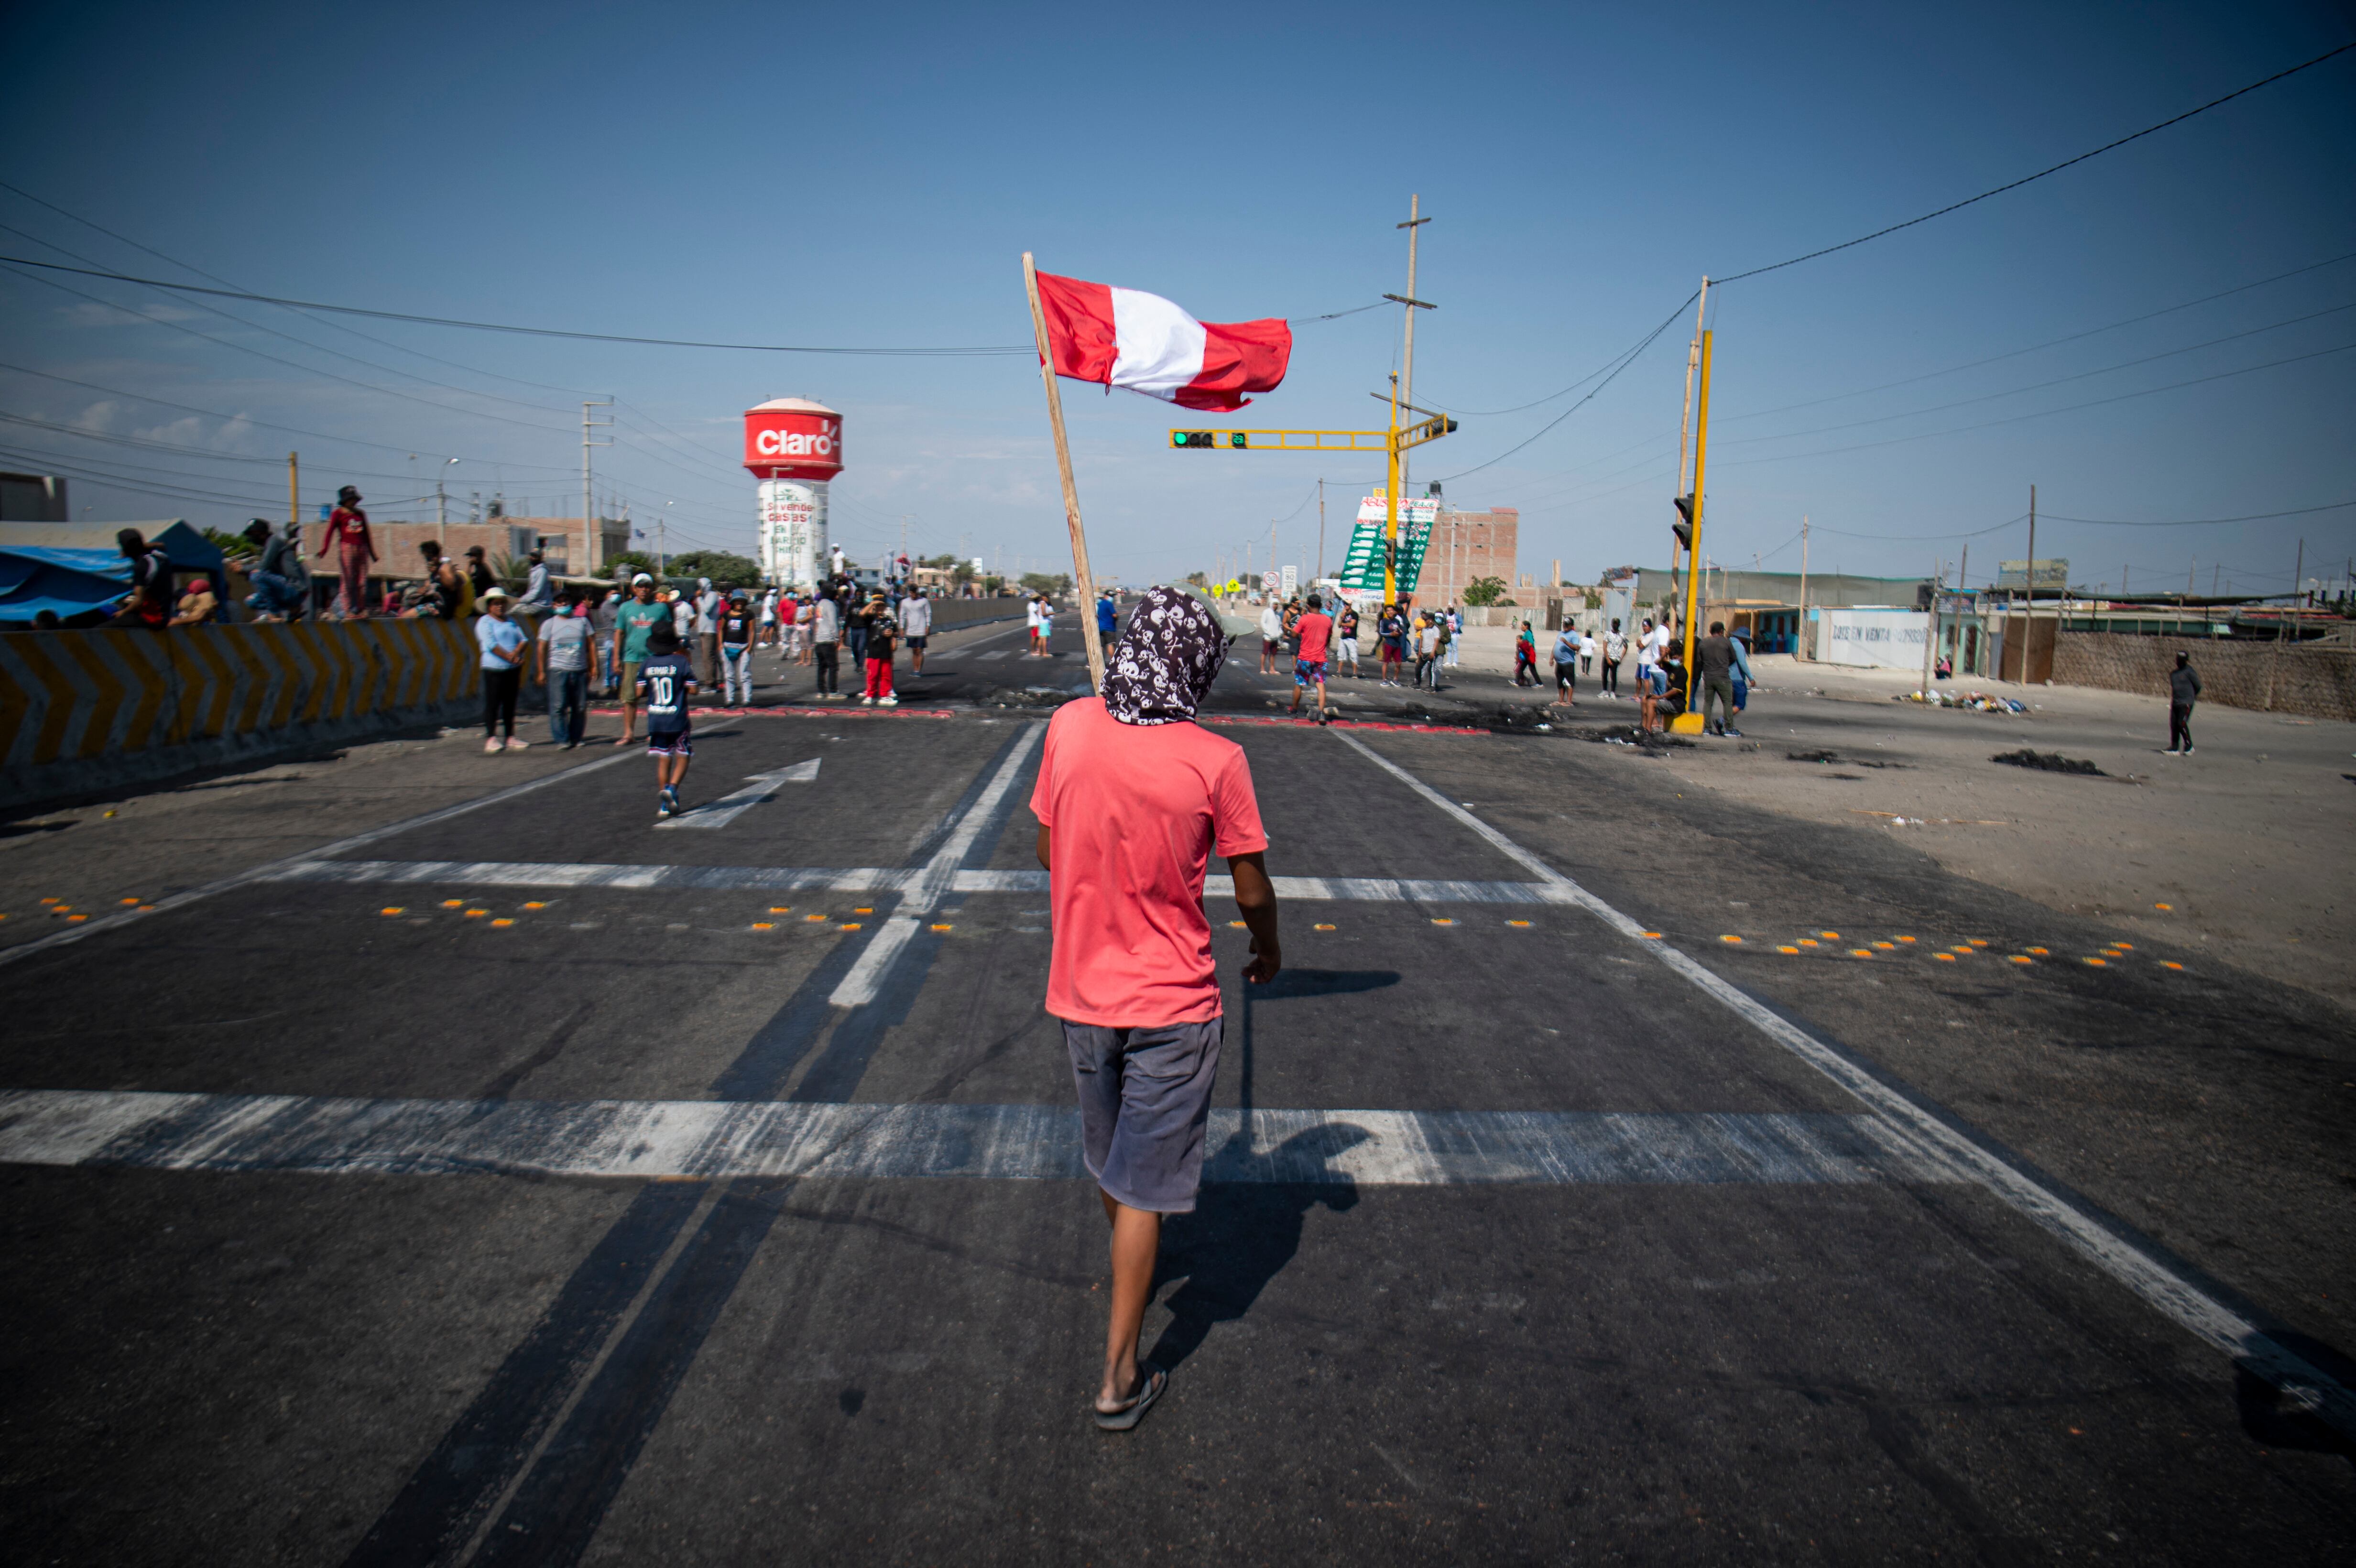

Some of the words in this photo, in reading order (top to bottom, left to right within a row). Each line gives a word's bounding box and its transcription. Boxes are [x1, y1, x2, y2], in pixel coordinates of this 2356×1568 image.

[757, 429, 832, 455] Claro
[781, 503, 812, 512] vende
[768, 512, 808, 523] casas
[1865, 626, 1890, 642] VENTA
[651, 676, 673, 705] 10
